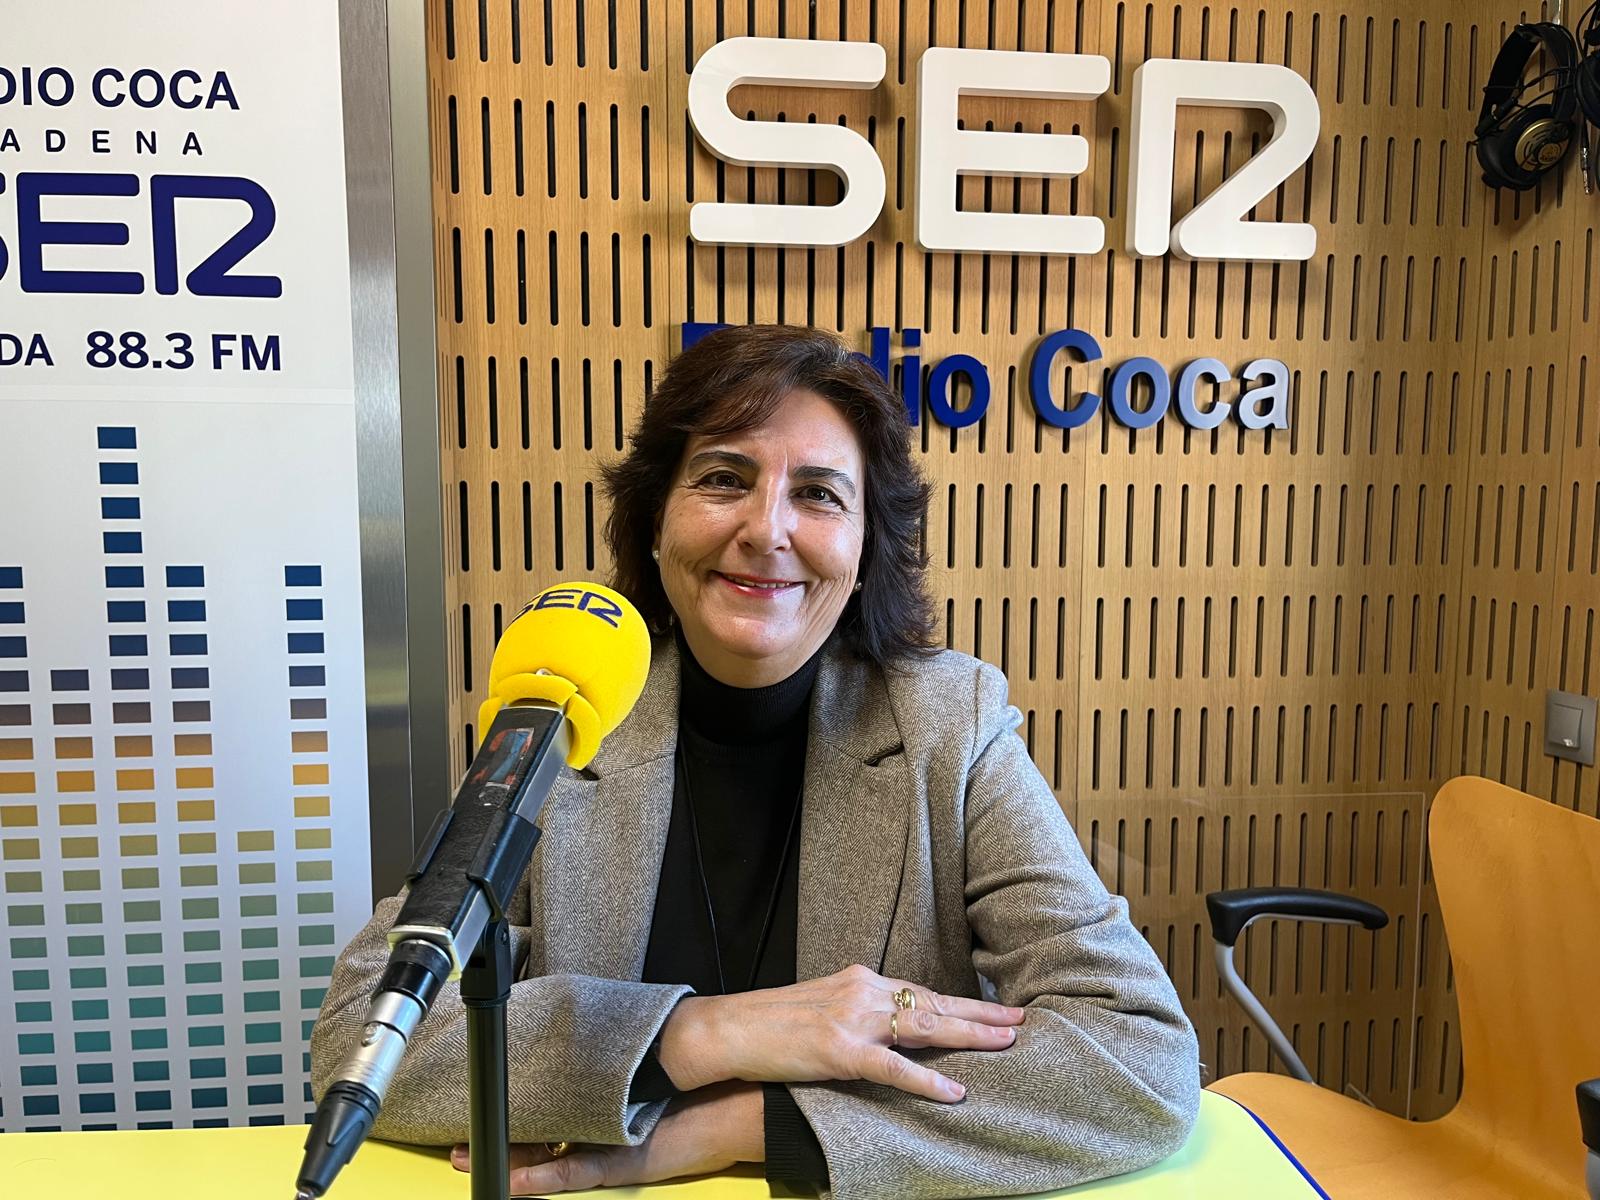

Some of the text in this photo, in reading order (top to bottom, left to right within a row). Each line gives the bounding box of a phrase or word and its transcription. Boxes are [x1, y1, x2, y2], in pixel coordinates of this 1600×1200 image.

[92, 67, 240, 110] COCA
[688, 37, 1321, 261] SER
[0, 172, 282, 298] ER
[86, 330, 194, 370] 88.3
[211, 333, 281, 371] FM
[1029, 328, 1291, 431] Coca
